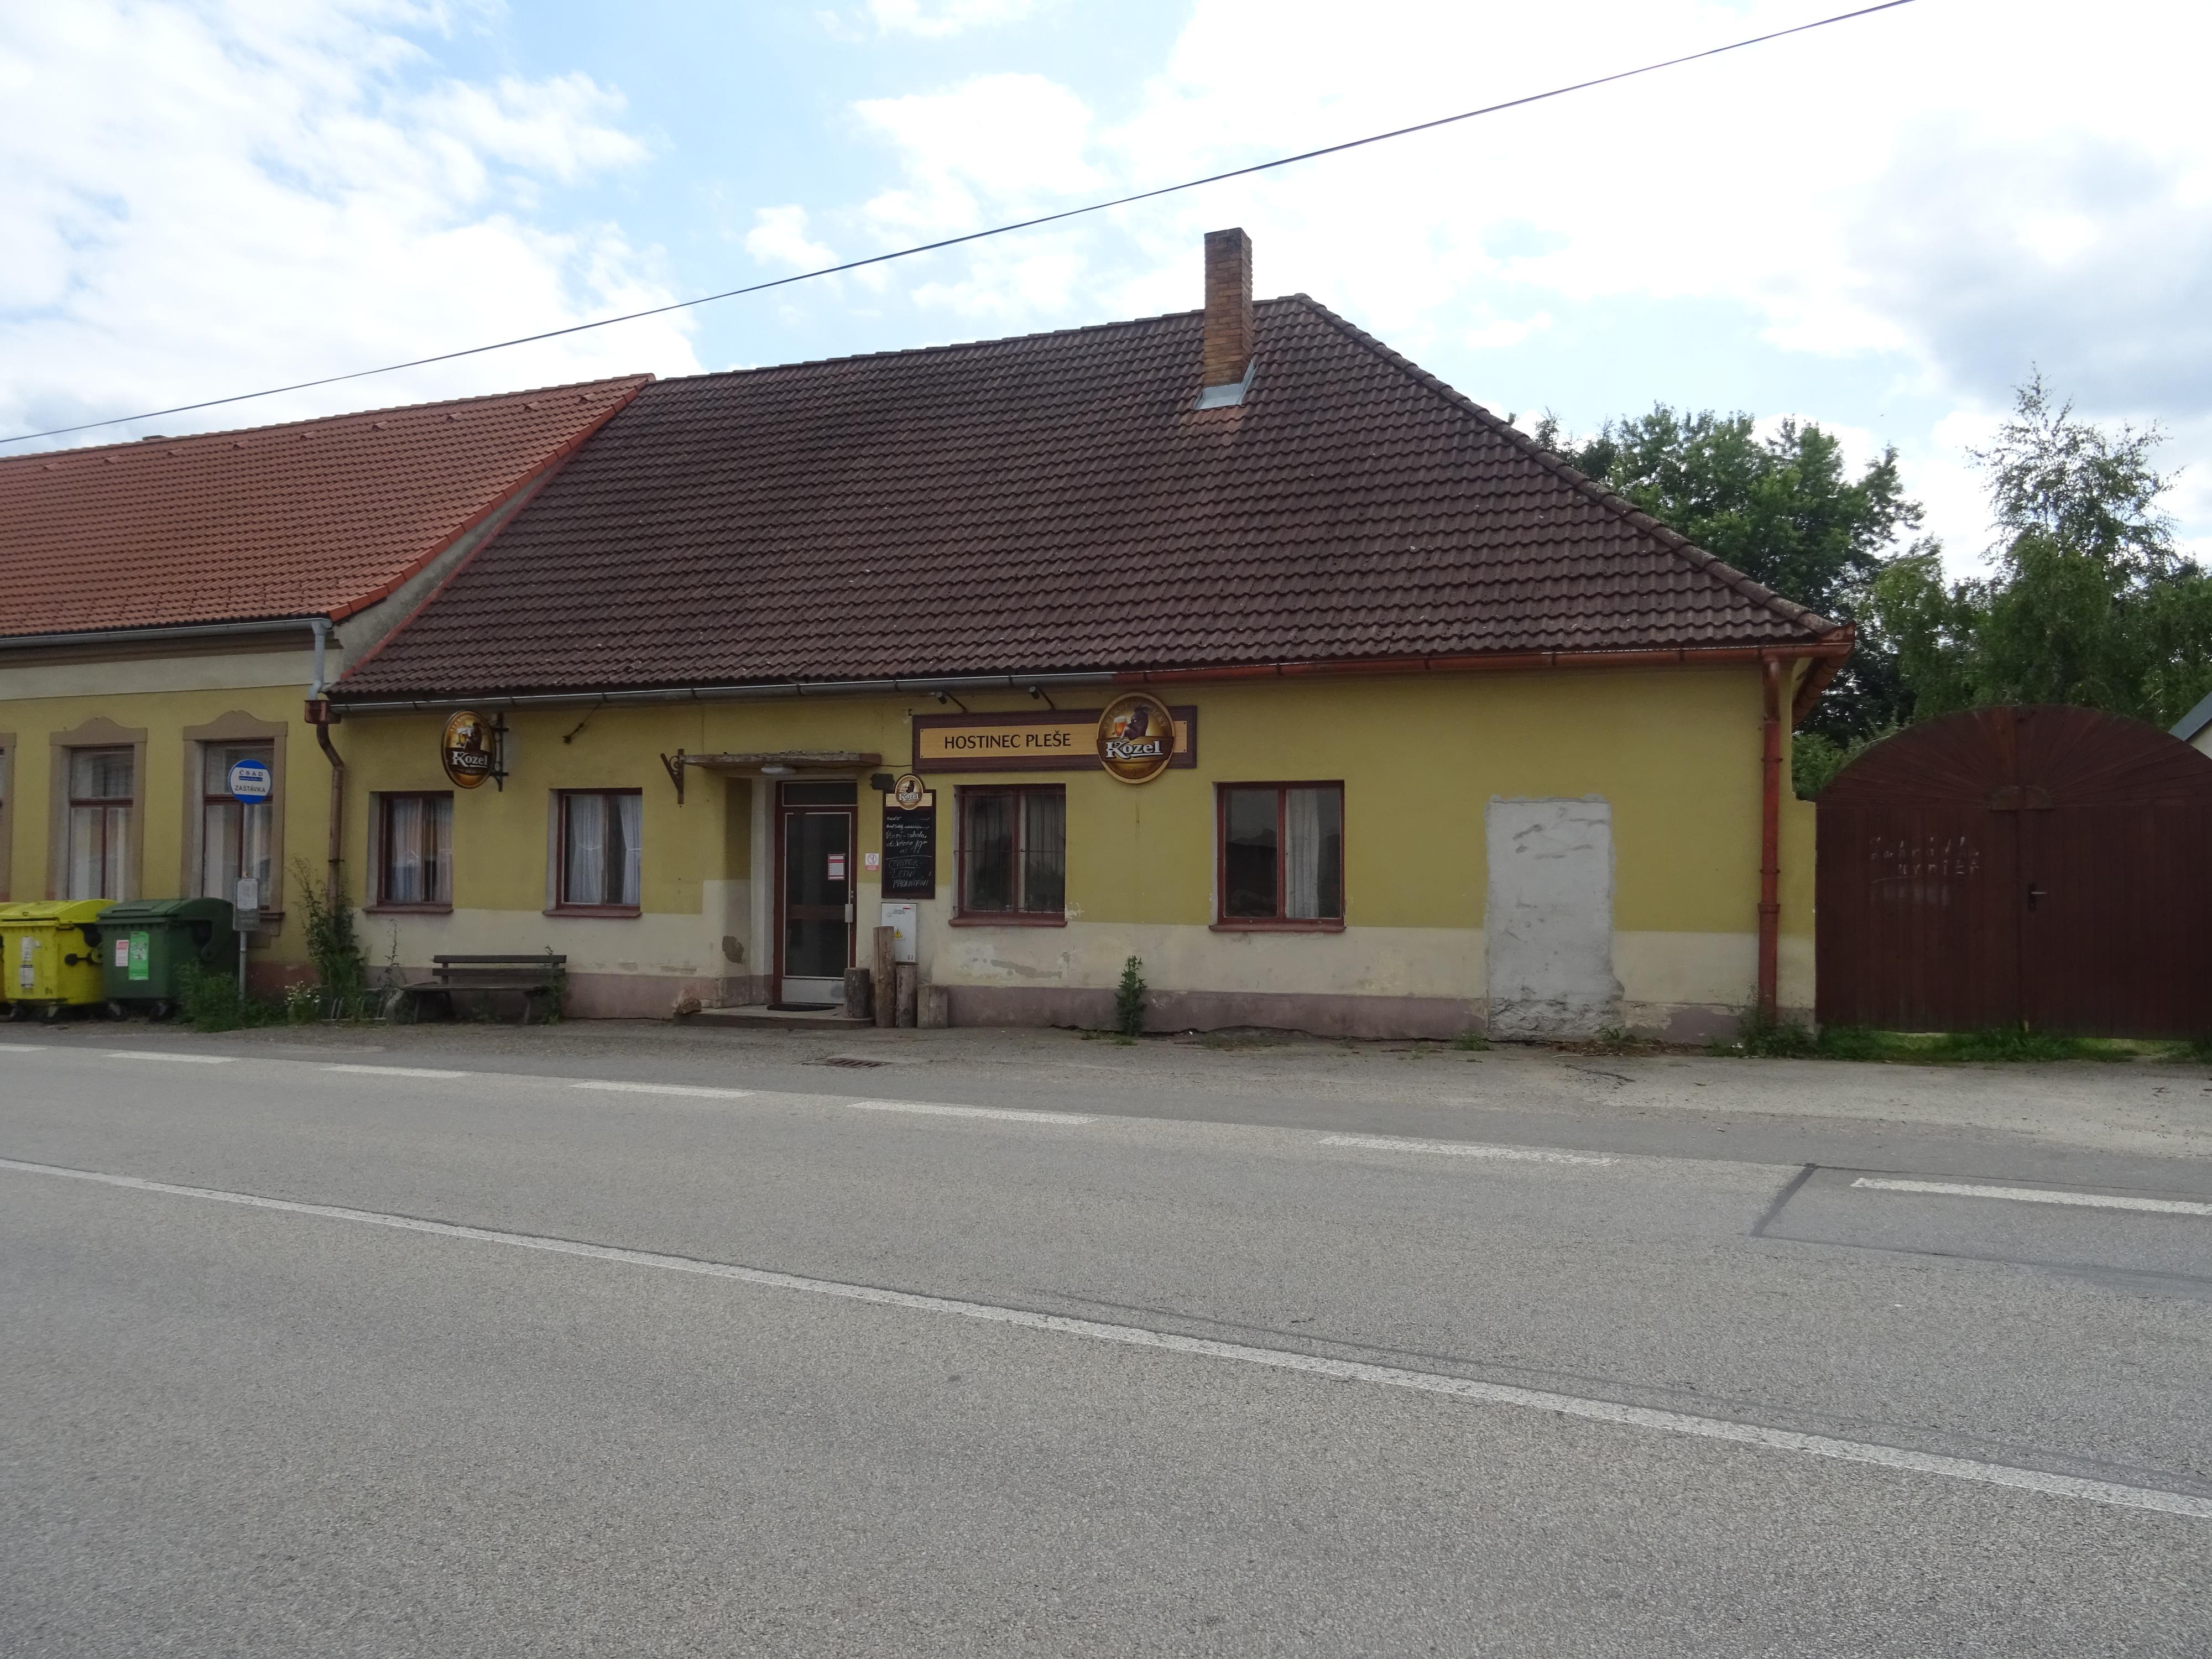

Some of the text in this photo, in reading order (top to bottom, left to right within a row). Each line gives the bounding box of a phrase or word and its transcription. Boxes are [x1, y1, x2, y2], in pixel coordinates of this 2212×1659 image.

[945, 730, 1071, 749] HOSTINEC PLEŠE
[1105, 740, 1164, 759] Kozel
[451, 751, 488, 768] Kozel
